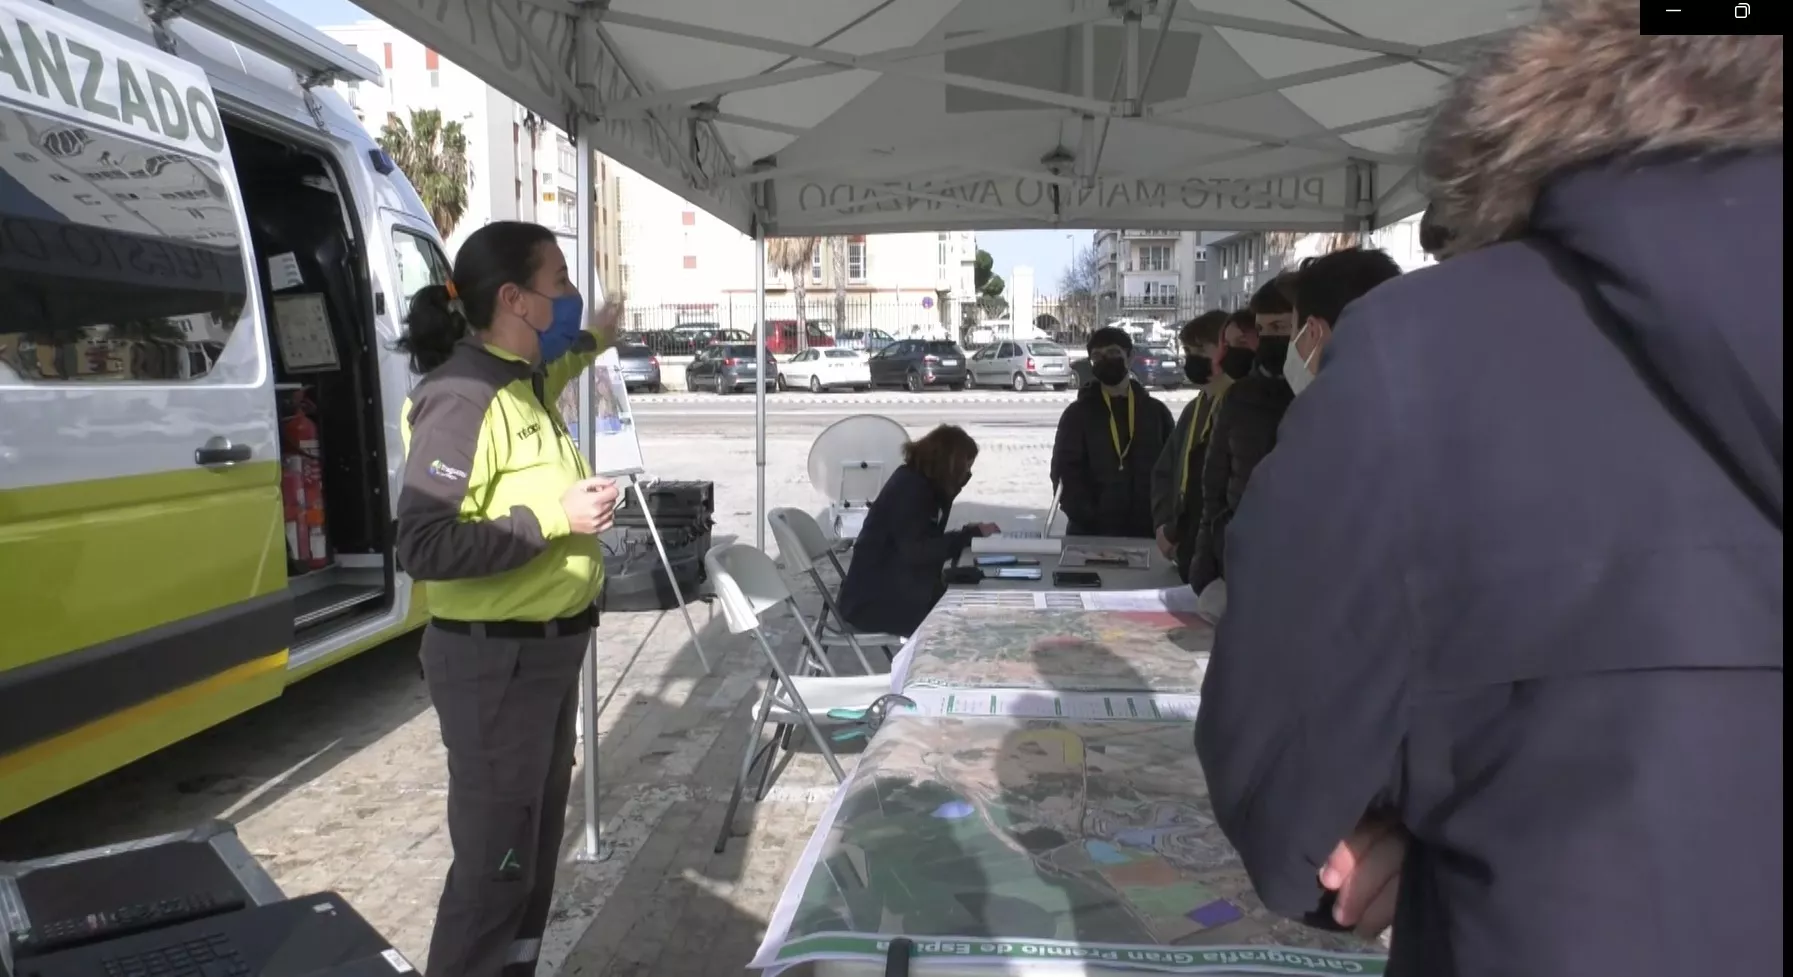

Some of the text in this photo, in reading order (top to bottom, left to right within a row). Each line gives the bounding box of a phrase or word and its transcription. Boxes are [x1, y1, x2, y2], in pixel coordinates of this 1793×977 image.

[980, 943, 1012, 953] de
[1022, 945, 1117, 960] Premio
[1128, 951, 1193, 964] Gran
